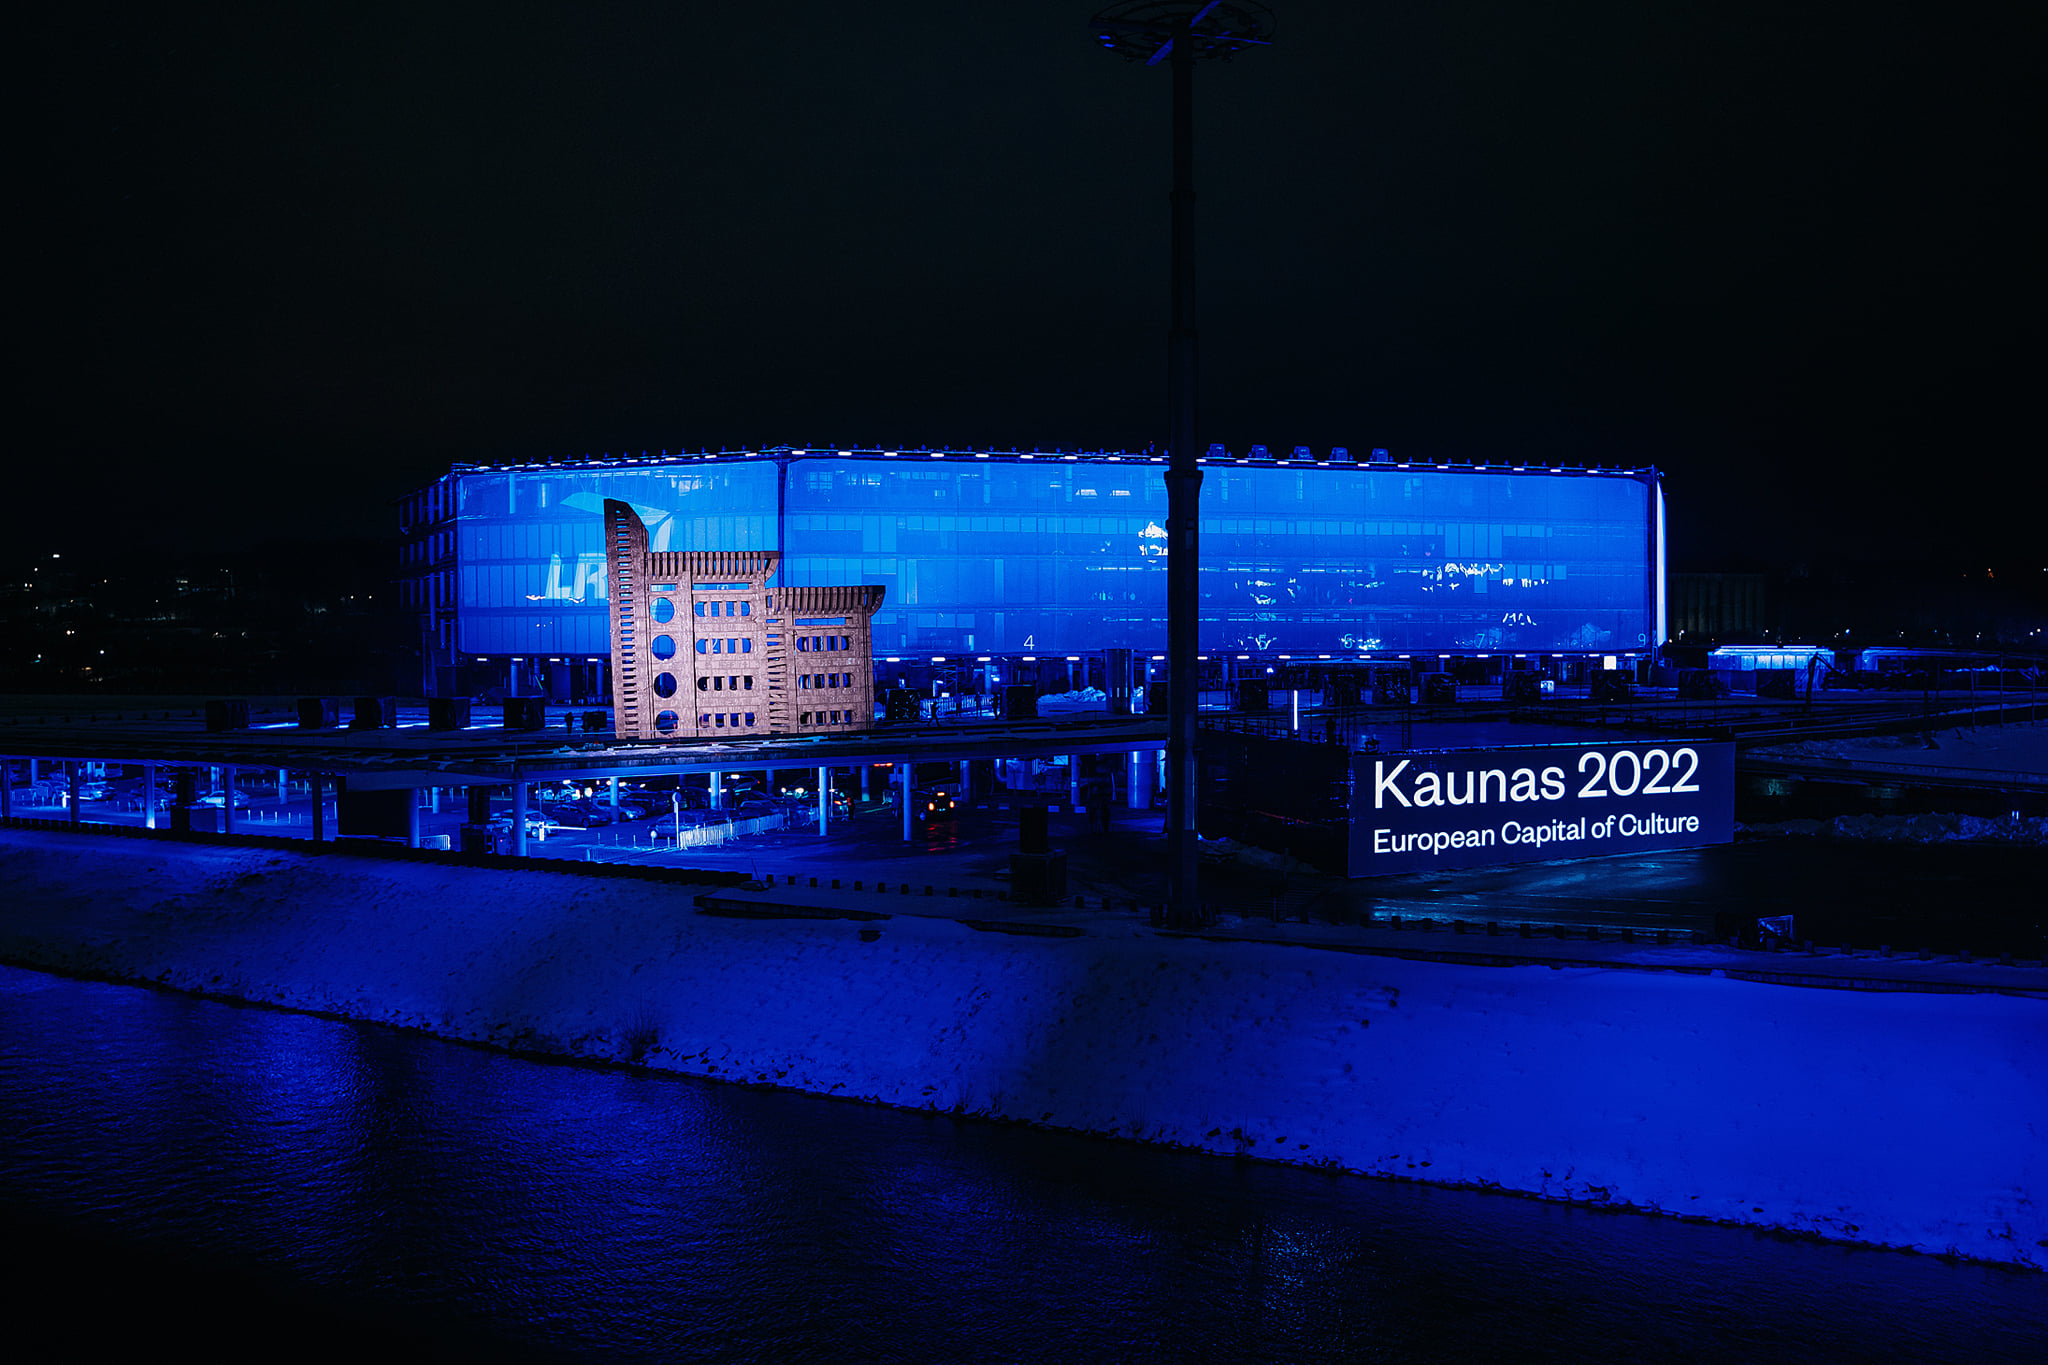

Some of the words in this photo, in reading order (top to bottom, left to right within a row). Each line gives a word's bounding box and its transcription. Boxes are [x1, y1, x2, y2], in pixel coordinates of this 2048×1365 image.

[1023, 634, 1035, 650] 4
[1637, 633, 1646, 648] 9
[1374, 759, 1566, 809] Kaunas
[1577, 747, 1700, 798] 2022
[1374, 828, 1496, 855] European
[1501, 816, 1586, 848] Capital
[1591, 815, 1617, 839] of
[1618, 812, 1700, 837] Culture
